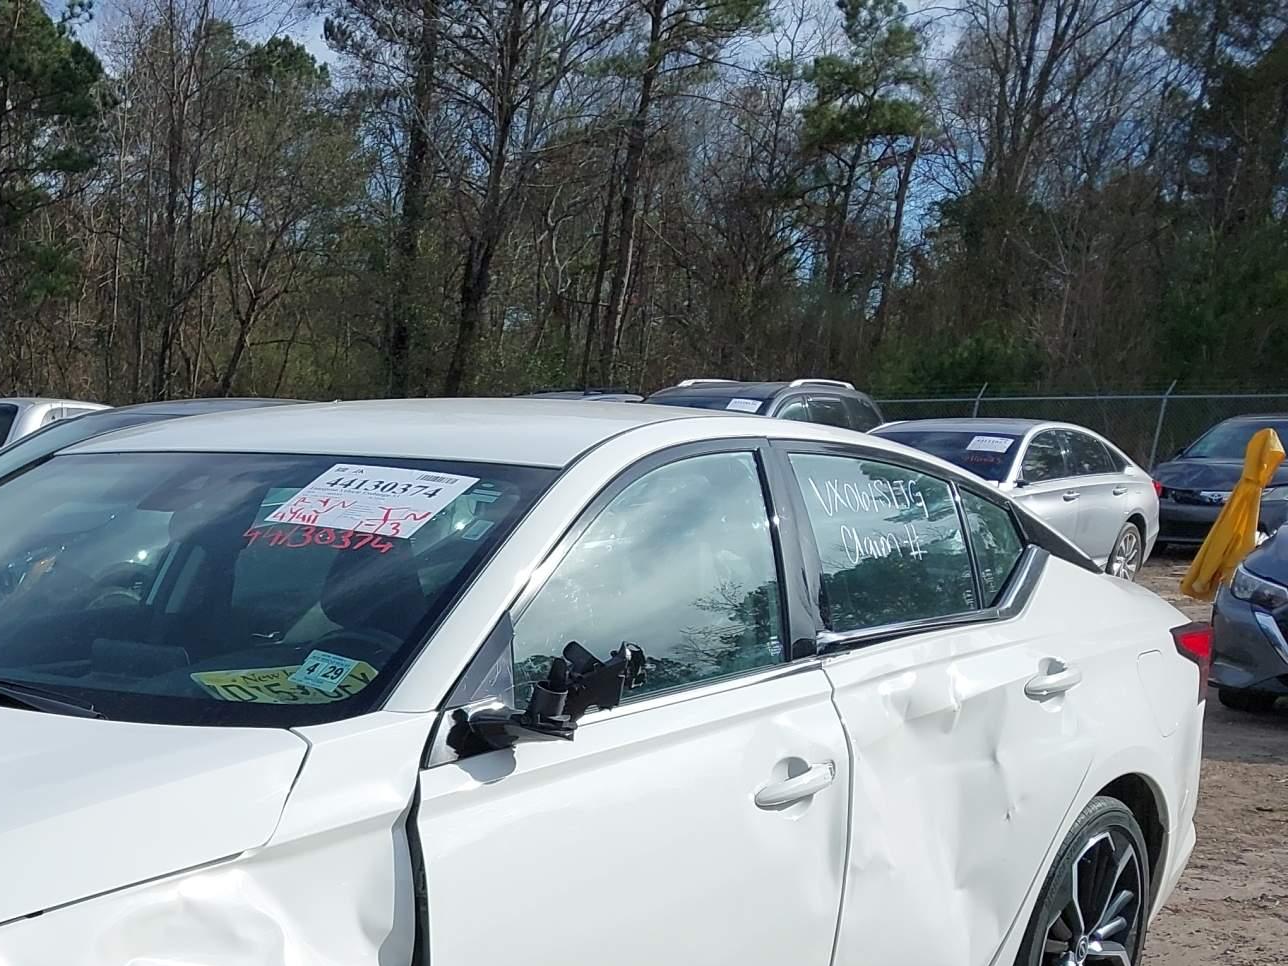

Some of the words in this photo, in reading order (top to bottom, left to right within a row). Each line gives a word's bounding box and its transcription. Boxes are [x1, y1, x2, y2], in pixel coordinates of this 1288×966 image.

[326, 477, 443, 498] 44130374
[306, 662, 321, 675] 4
[321, 665, 344, 680] 29
